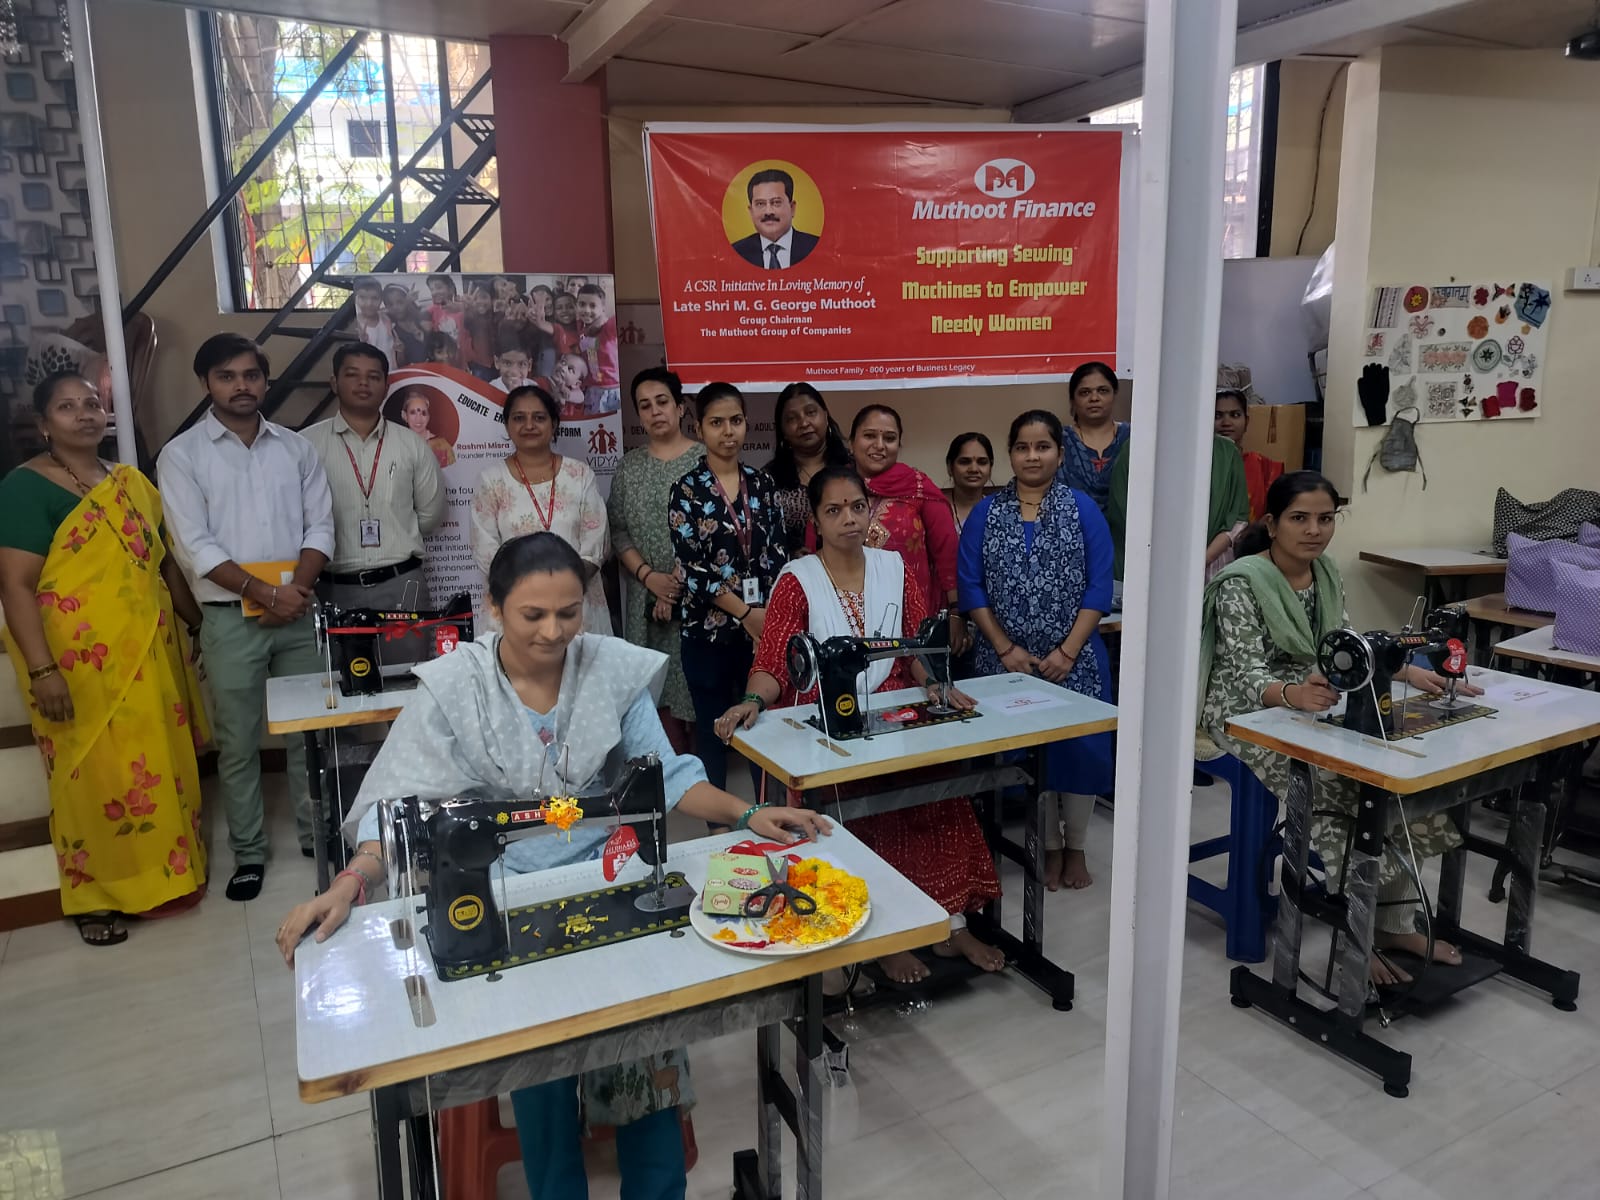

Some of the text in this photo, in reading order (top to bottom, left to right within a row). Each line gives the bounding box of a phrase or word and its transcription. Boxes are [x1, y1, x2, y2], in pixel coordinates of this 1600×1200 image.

[912, 200, 1096, 220] Muthoot Finance
[916, 244, 1073, 268] Supporting Sewing
[684, 276, 866, 294] A CSR Initiative In Loving Memory of
[902, 279, 1088, 300] Machines to Empower
[673, 297, 876, 312] Late Shri M. G. George Muthoot
[739, 315, 813, 326] Group Chairman
[931, 314, 1053, 336] Needy Women
[700, 325, 852, 338] The Muthoot Group of Companies
[805, 367, 838, 375] Muthoot
[839, 367, 864, 376] Family
[916, 364, 948, 372] Business
[949, 364, 976, 372] Legacy
[457, 393, 490, 417] EDUCATE
[457, 441, 510, 450] Rashmi Misra
[457, 451, 485, 459] Founder
[586, 455, 618, 467] VIDYA
[435, 533, 460, 541] School
